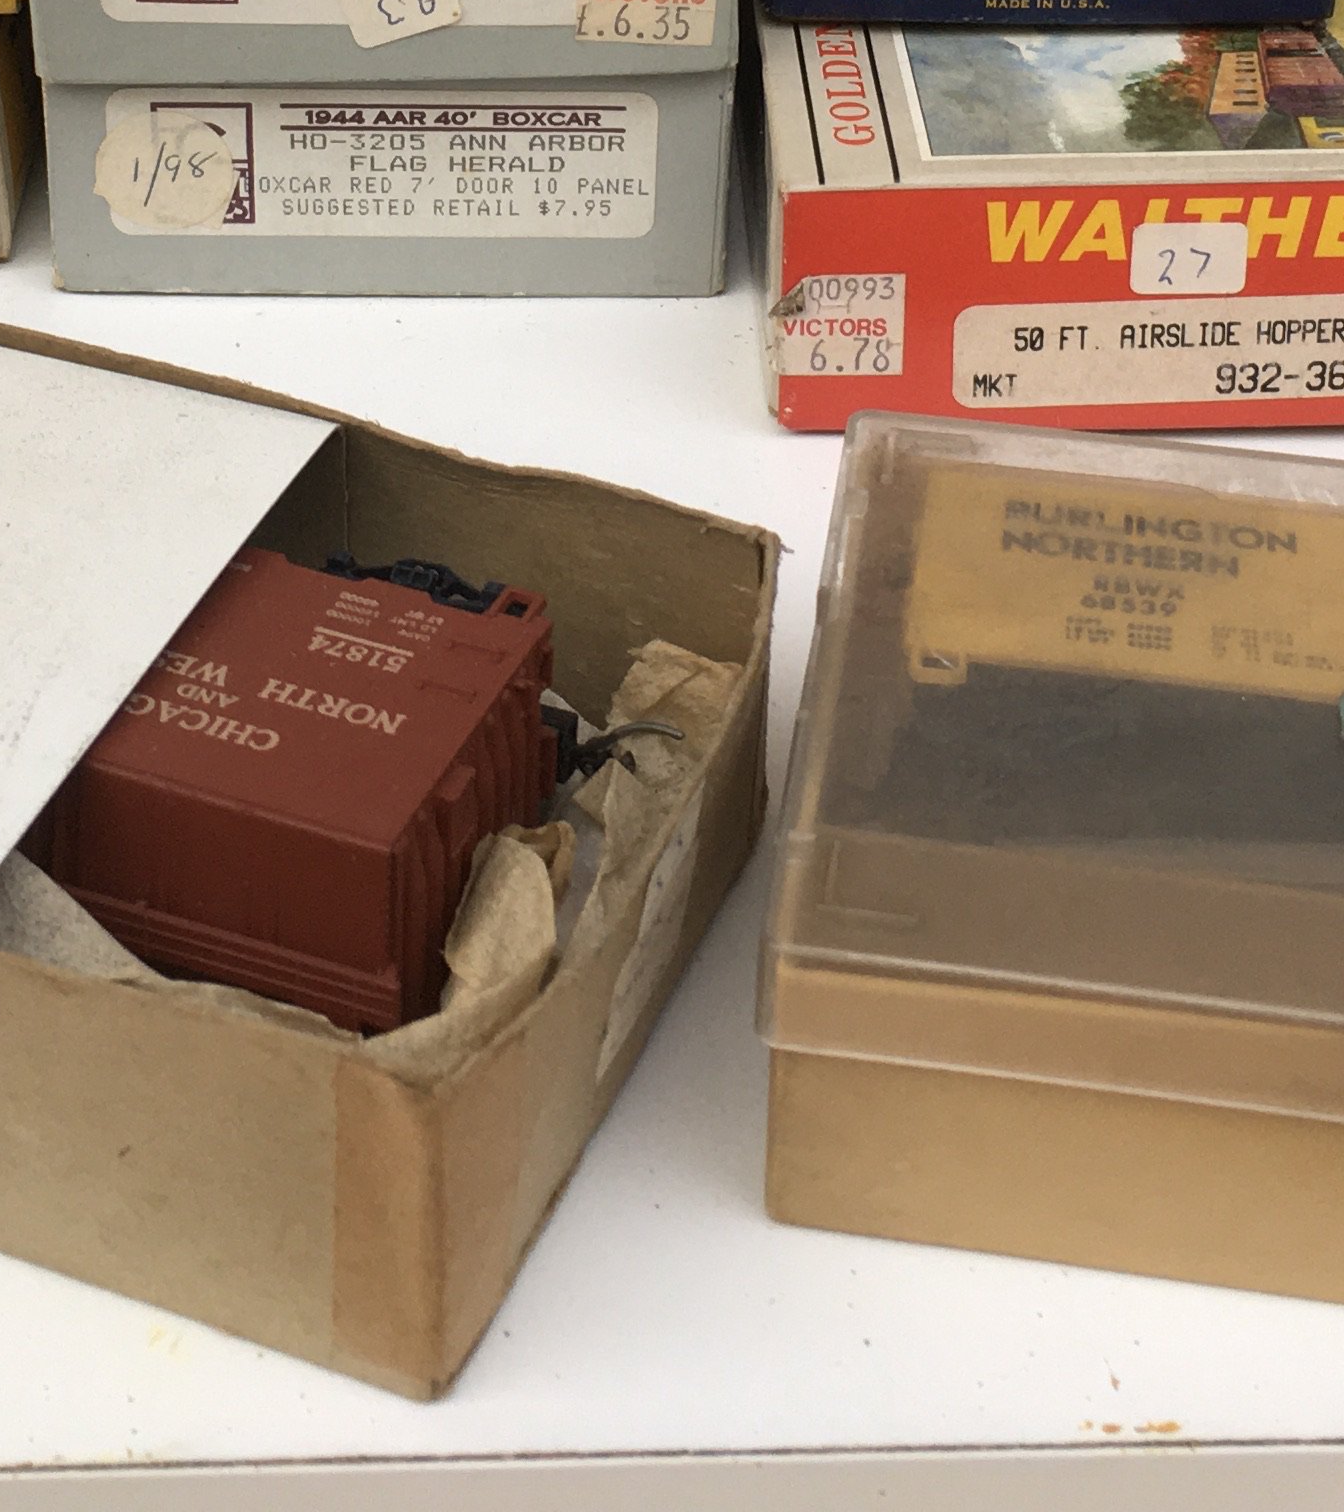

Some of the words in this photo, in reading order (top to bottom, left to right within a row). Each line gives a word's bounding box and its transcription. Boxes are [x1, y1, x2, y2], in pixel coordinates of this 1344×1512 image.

[304, 109, 365, 127] 1944
[375, 110, 429, 127] AAR
[493, 110, 601, 128] BOXCAR
[289, 133, 426, 152] HO-3205
[449, 133, 508, 152] ANN
[528, 133, 625, 153] ARBOR
[350, 155, 428, 173] FLAG
[448, 155, 566, 174] HERALD
[349, 177, 393, 195] RED
[456, 177, 516, 196] DOOR
[533, 177, 558, 196] 10
[576, 177, 650, 197] PANEL
[282, 198, 416, 218] SUGGESTED
[433, 199, 520, 218] RETAIL
[538, 199, 612, 219] $7.95
[781, 318, 888, 336] VICTORS
[1013, 326, 1045, 353] 50
[1120, 319, 1242, 350] AIRSLIDE
[973, 372, 1018, 398] MKT
[1004, 499, 1299, 555] BURLINGTON
[1001, 529, 1241, 579] NORTHERN
[307, 633, 408, 674] 51874
[176, 683, 240, 708] AND
[256, 677, 407, 736] NORTH
